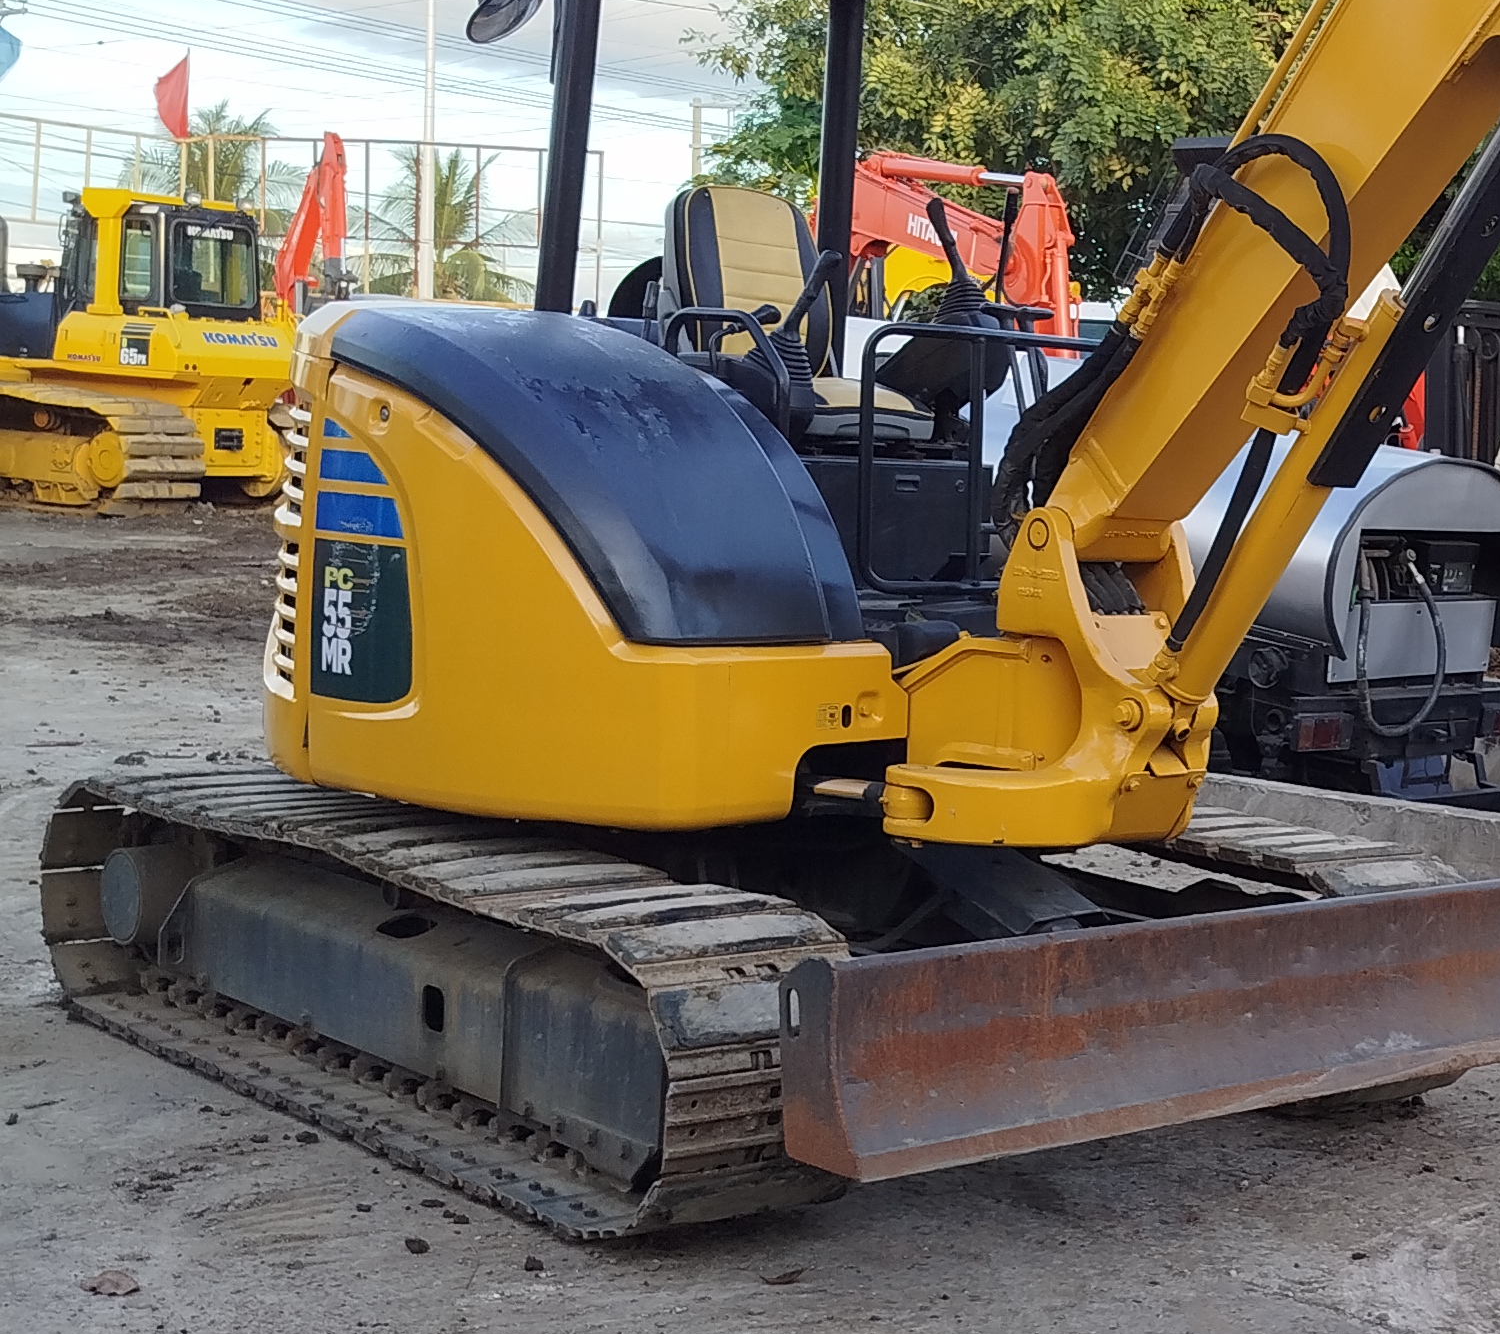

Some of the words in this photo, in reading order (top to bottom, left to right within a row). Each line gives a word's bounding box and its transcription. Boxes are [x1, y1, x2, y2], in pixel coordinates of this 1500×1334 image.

[202, 331, 279, 349] KOMATSU
[323, 566, 355, 590] PC
[322, 588, 352, 639] 55
[321, 635, 353, 676] MR
